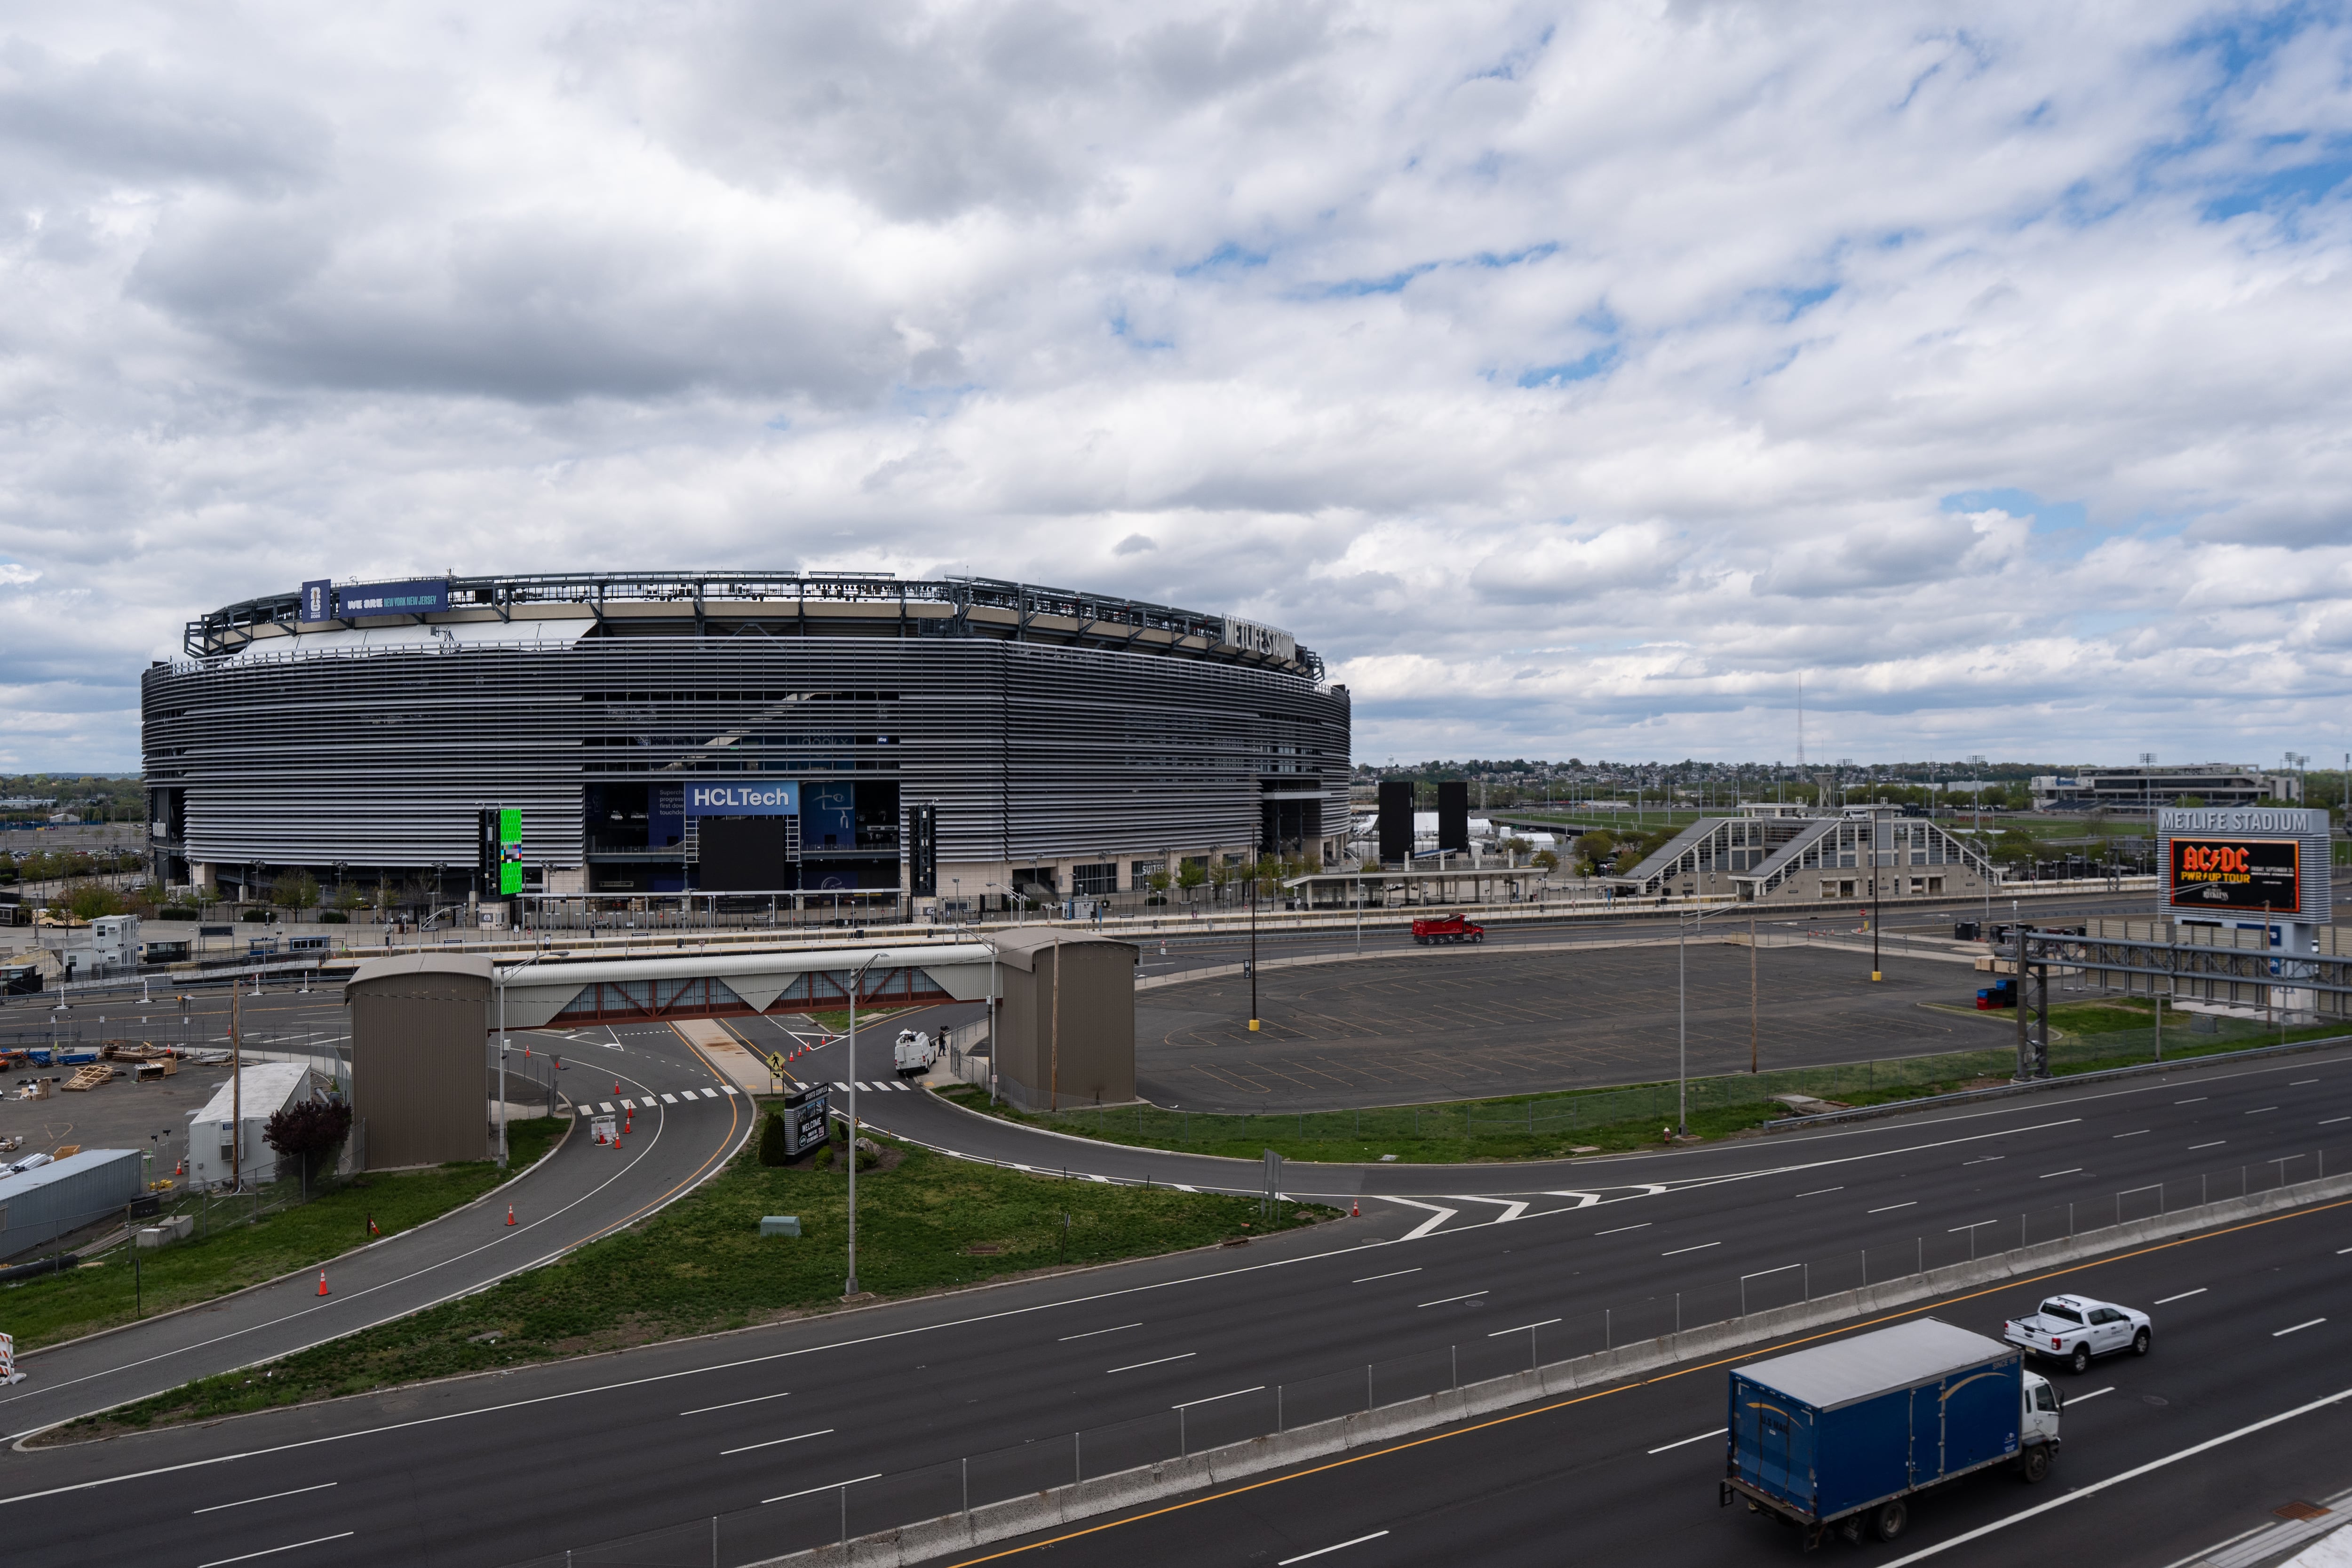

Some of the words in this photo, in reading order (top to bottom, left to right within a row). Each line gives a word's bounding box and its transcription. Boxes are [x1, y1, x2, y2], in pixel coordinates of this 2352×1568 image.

[348, 600, 362, 610] WE
[364, 598, 383, 609] ARE
[384, 597, 394, 607] NEW
[394, 596, 406, 606] YORK
[407, 596, 418, 606] NEW
[419, 595, 437, 605] JERSEY
[1225, 618, 1264, 654] METLIFE
[1265, 629, 1295, 661] STADIUM
[694, 788, 789, 806] HCLTech
[2162, 813, 2227, 829] METLIFE
[2233, 813, 2308, 831] STADIUM
[1142, 864, 1165, 874] SUITES
[2181, 871, 2202, 880] PWR
[2209, 872, 2221, 882] UP
[2223, 873, 2250, 883] TOUR
[805, 1091, 816, 1101] SPORTS
[816, 1085, 827, 1096] COMPLEX
[802, 1117, 821, 1133] WELCOME
[1993, 1358, 2008, 1370] SINCE
[1773, 1420, 1789, 1435] MAIL
